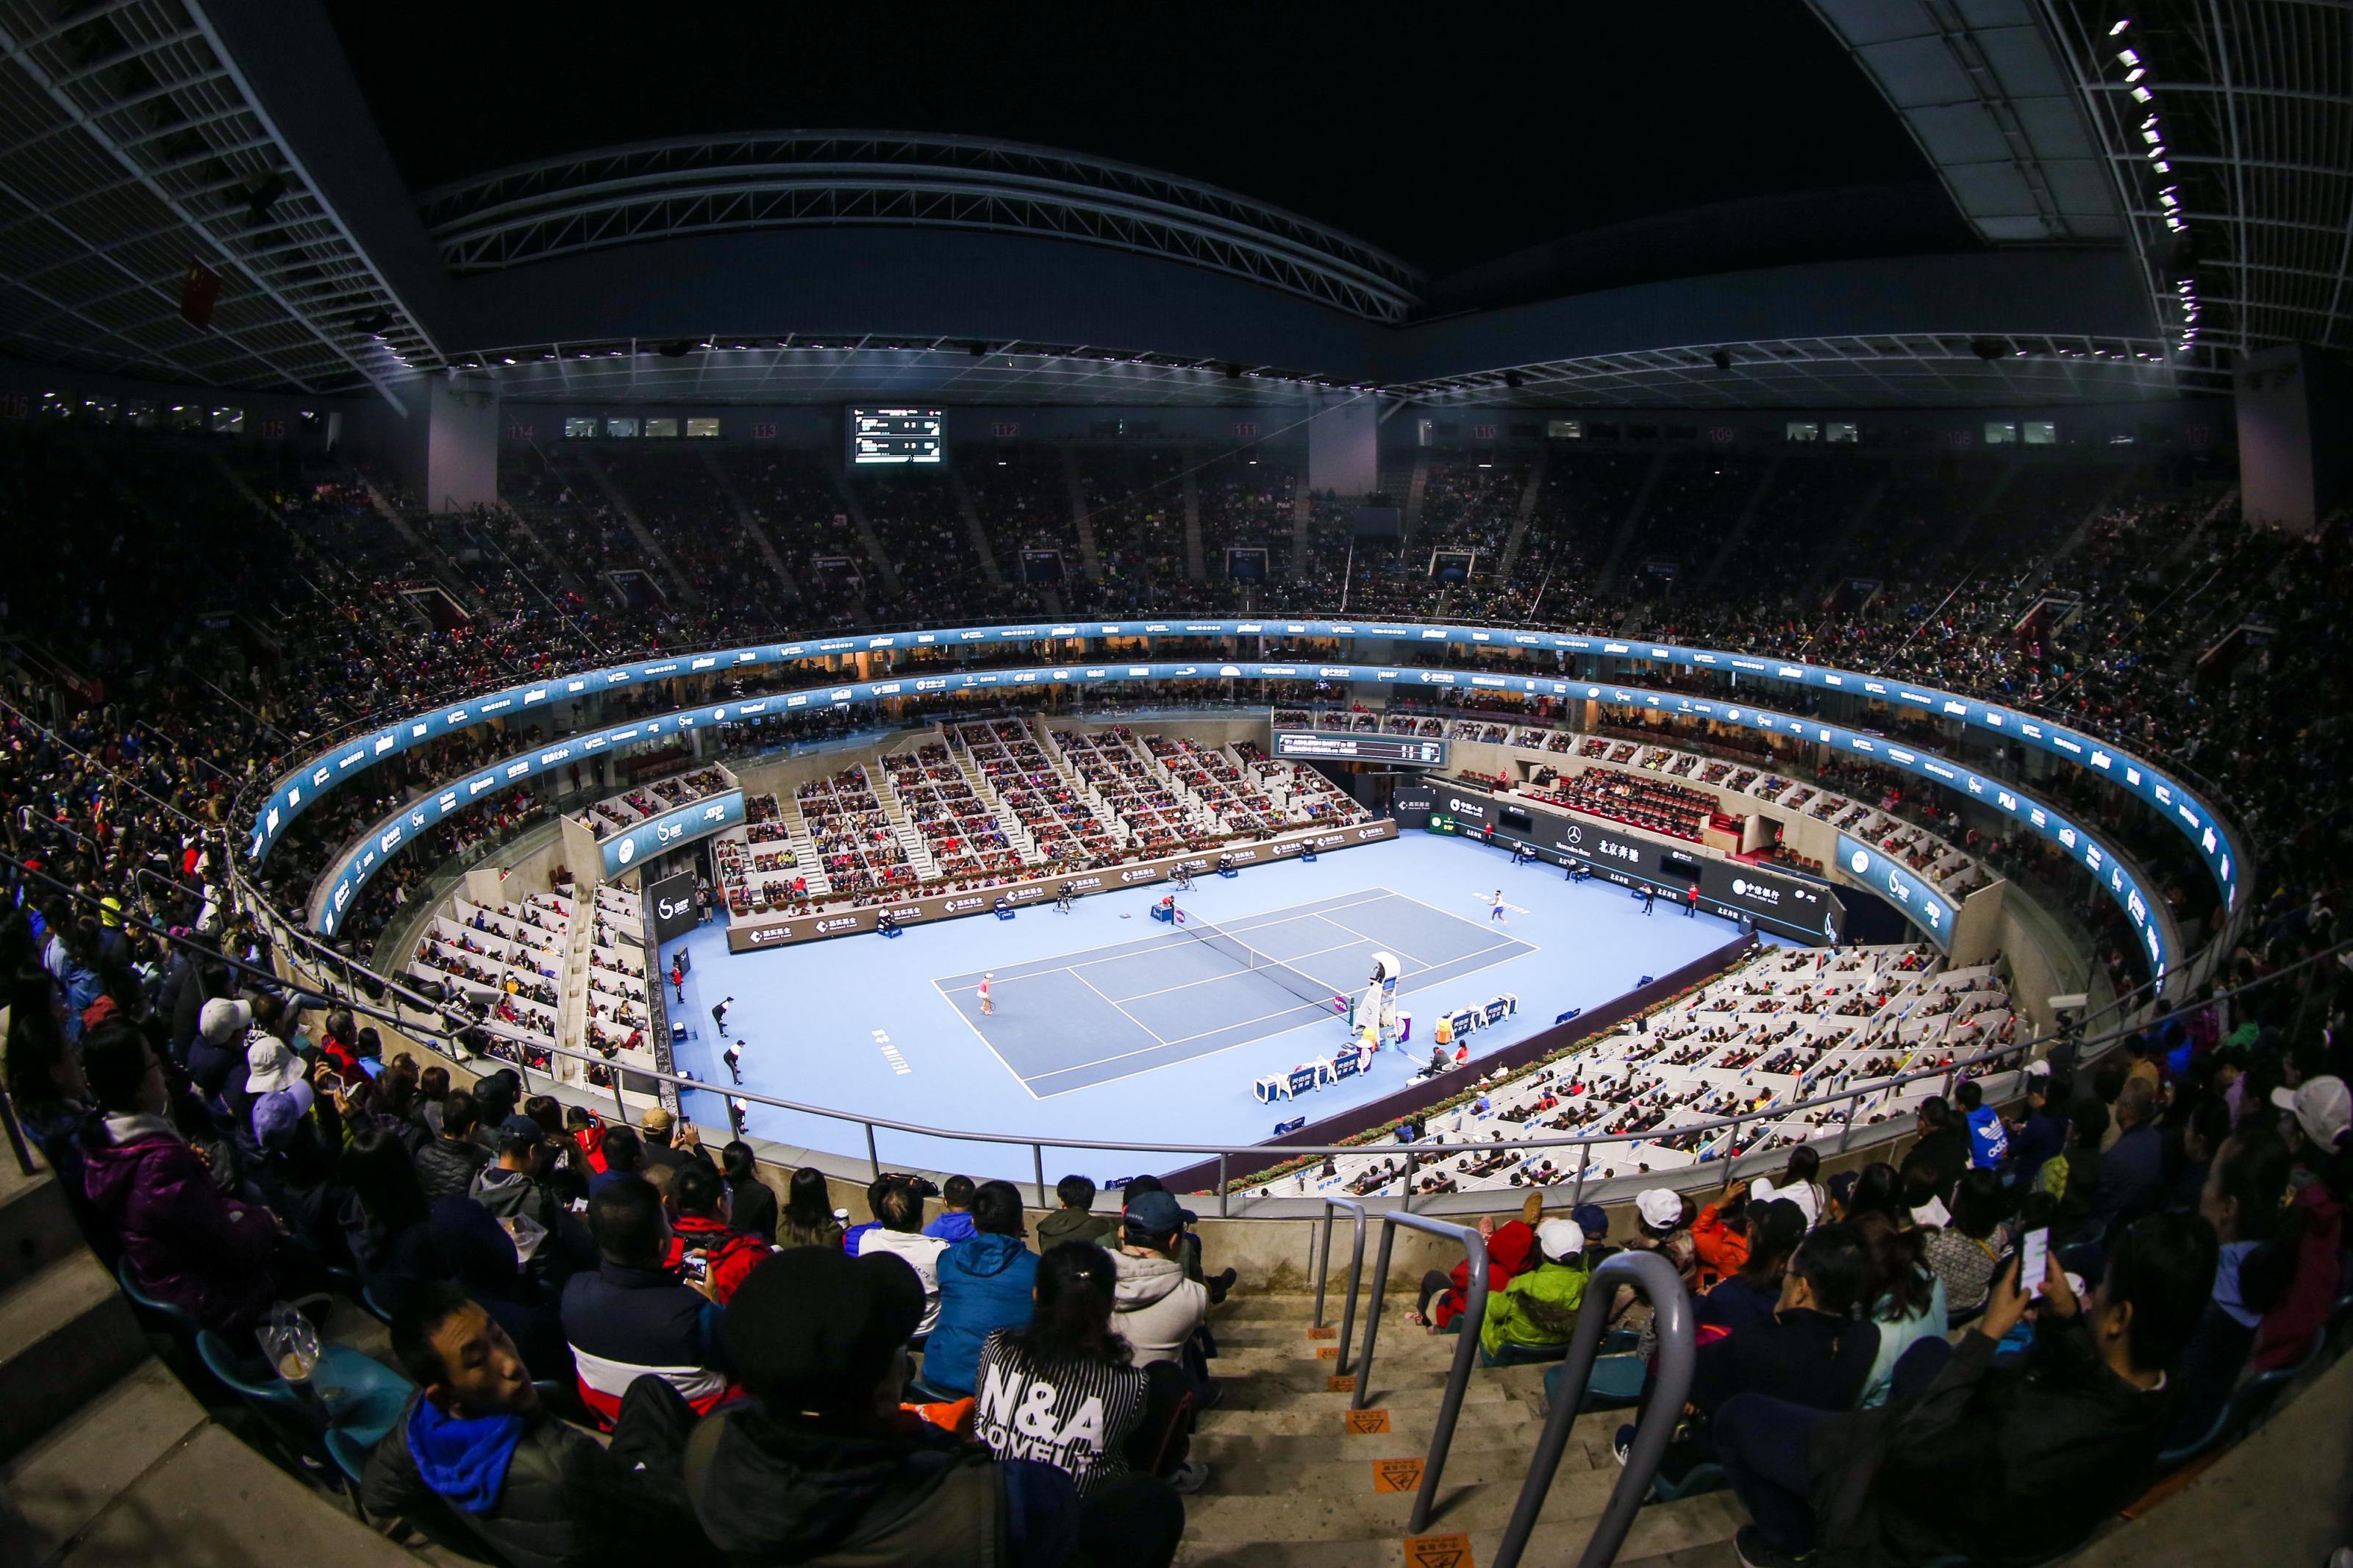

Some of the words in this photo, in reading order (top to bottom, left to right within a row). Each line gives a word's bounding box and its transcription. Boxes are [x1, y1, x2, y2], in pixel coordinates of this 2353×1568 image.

[261, 420, 285, 437] 115
[508, 424, 532, 438] 114
[753, 424, 776, 437] 113
[993, 423, 1018, 435] 112
[1234, 423, 1257, 435] 111
[1472, 426, 1497, 439] 110
[1709, 429, 1733, 442] 109
[1947, 431, 1971, 445] 108
[704, 805, 724, 820] ATP
[621, 846, 632, 856] WTA
[1556, 841, 1591, 858] Mercedes-Benz
[1599, 840, 1639, 863] 北京奔驰
[1018, 887, 1043, 896] 嘉实基金
[1746, 883, 1780, 900] 中信银行
[957, 897, 983, 907] 嘉实基金
[893, 907, 921, 916] 嘉实基金
[829, 917, 857, 927] 嘉实基金
[763, 927, 792, 937] 嘉实基金
[1334, 998, 1347, 1011] WTA
[881, 1045, 912, 1075] BEIJING
[979, 1361, 1104, 1453] N&A
[975, 1417, 1094, 1474] LOVELY
